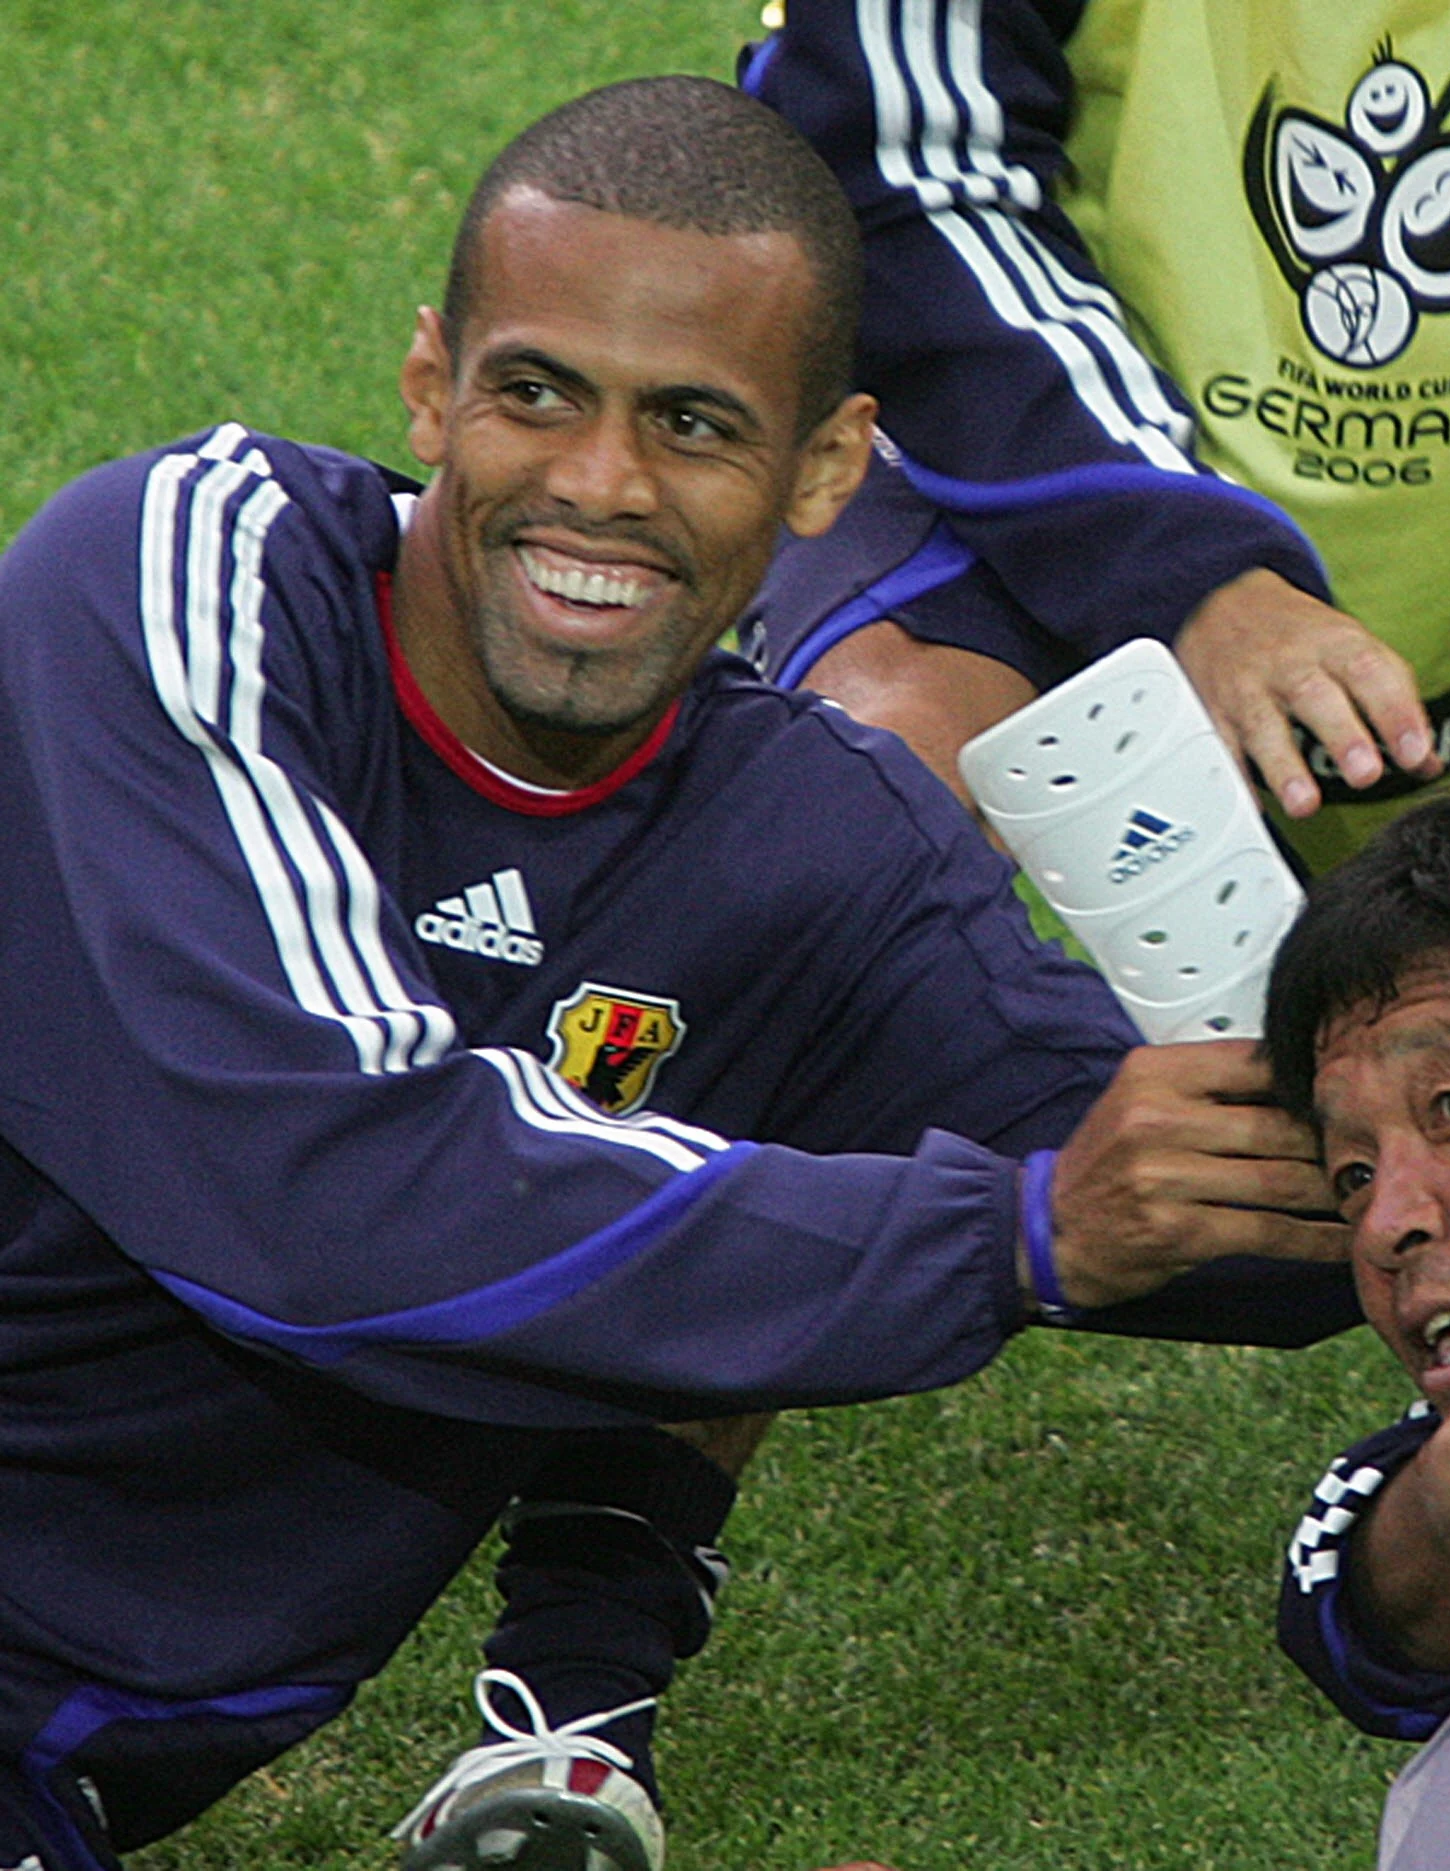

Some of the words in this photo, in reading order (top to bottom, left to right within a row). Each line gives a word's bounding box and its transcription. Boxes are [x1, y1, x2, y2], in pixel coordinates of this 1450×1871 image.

[1278, 356, 1320, 394] FIFA
[1323, 377, 1412, 402] WORLD
[1293, 449, 1432, 487] 2006
[1108, 826, 1197, 885] adidas
[415, 912, 545, 966] adidas
[579, 1006, 661, 1044] JFA
